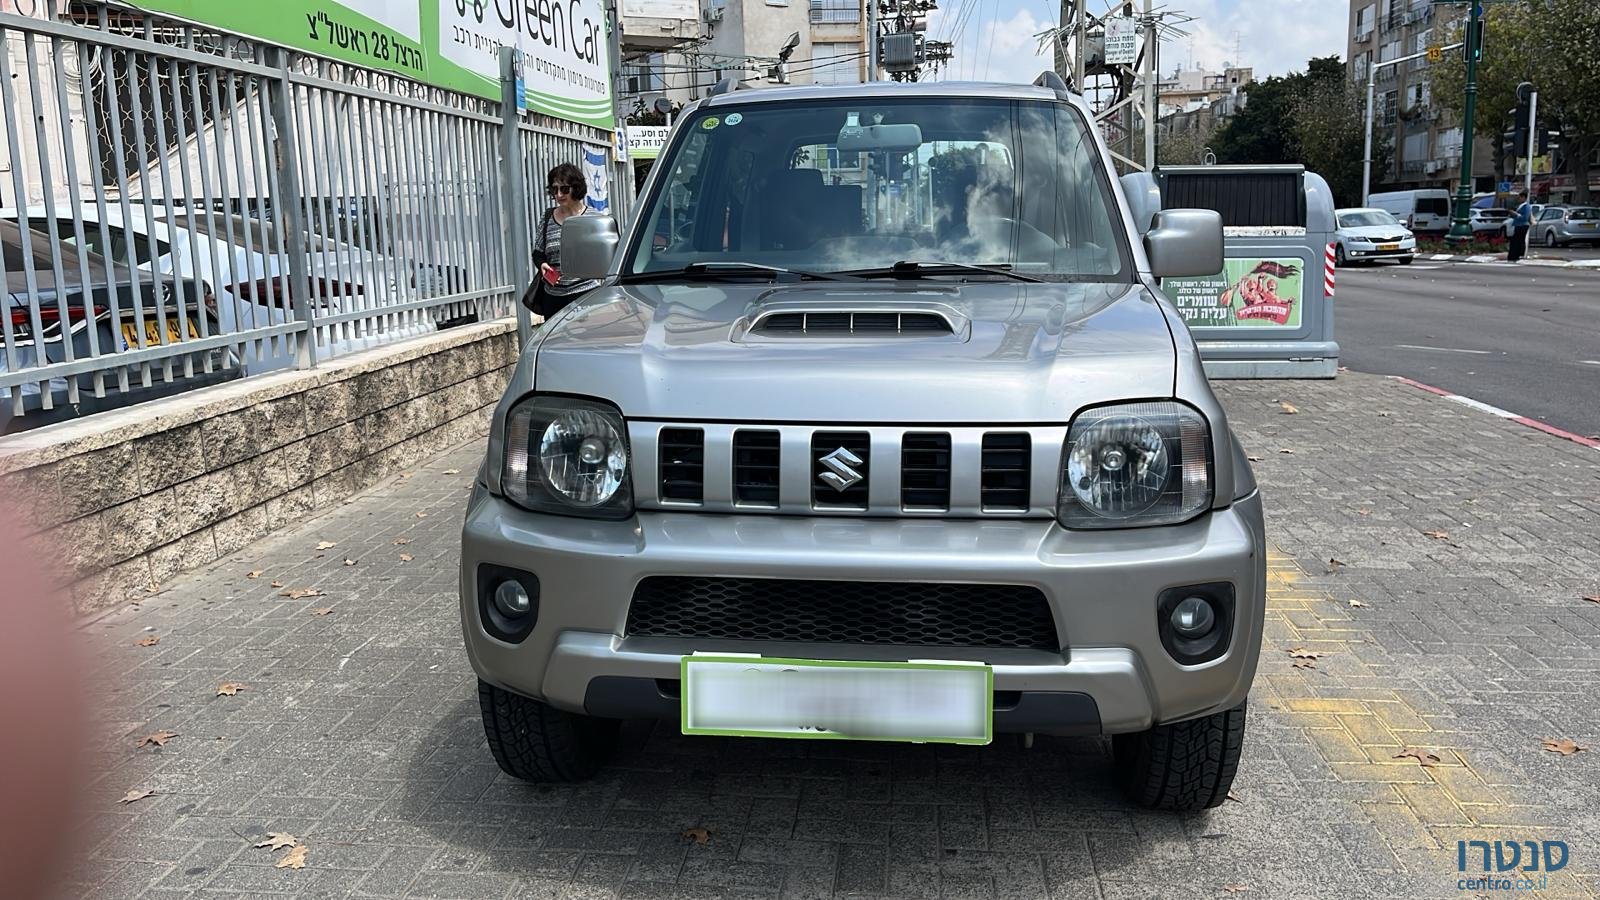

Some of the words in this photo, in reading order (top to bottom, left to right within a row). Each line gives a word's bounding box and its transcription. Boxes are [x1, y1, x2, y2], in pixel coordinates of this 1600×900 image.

[453, 25, 472, 47] רכב
[569, 0, 600, 66] Car
[371, 31, 389, 61] 28
[392, 36, 423, 71] הרצל
[1430, 49, 1440, 57] 13
[536, 57, 566, 82] מתקדמים
[568, 69, 583, 87] מימון
[658, 129, 669, 138] לם
[629, 139, 640, 148] קצ
[655, 138, 666, 147] לנו
[1177, 296, 1217, 307] שומרים
[1201, 307, 1227, 319] עליה
